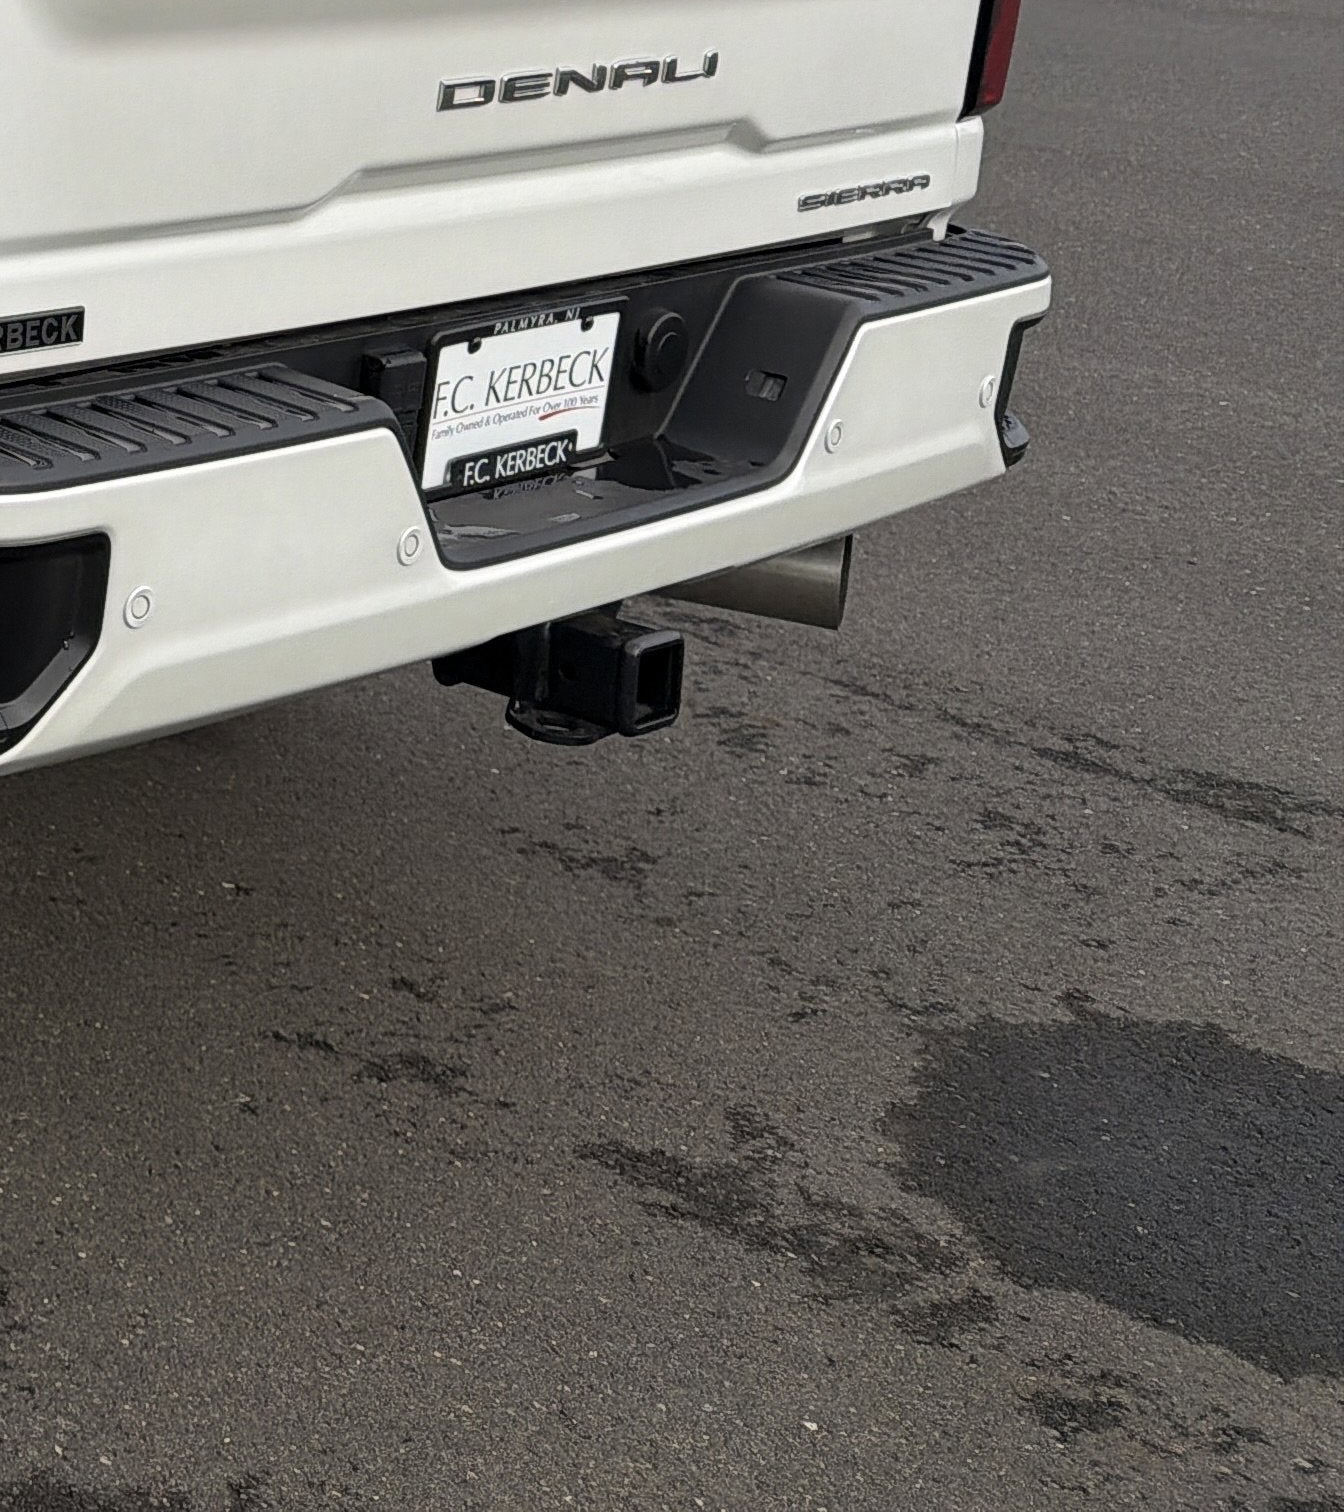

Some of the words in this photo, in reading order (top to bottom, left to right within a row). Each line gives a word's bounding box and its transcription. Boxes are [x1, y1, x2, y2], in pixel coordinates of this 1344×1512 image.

[436, 47, 719, 113] DENALI
[797, 174, 931, 213] SIERRA
[432, 375, 475, 419] F.C.
[484, 347, 609, 407] KERBECK
[432, 426, 455, 440] Family
[455, 418, 483, 434] Owned
[484, 417, 491, 426] &
[493, 406, 528, 425] Operated
[528, 403, 541, 416] For
[543, 401, 562, 413] Over
[563, 396, 577, 407] 100
[579, 394, 599, 405] Years
[463, 459, 491, 487] F.C.
[495, 439, 569, 479] KERBECK
